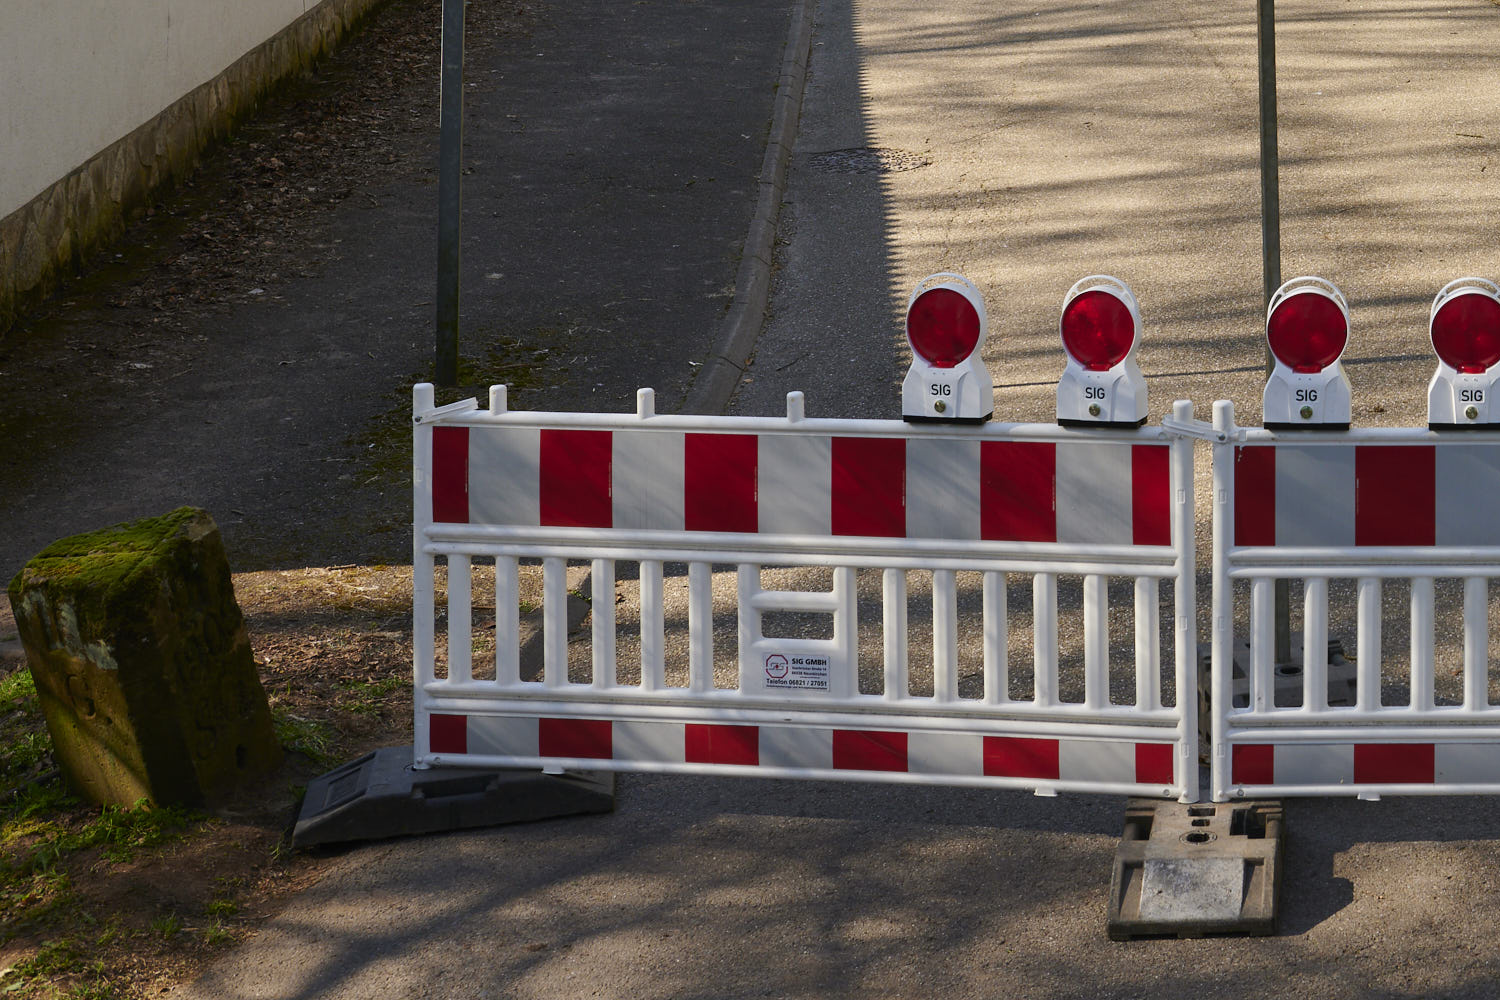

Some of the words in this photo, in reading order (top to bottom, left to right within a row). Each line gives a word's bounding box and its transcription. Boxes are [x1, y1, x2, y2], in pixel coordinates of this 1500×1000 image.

[931, 384, 951, 396] SIG
[1085, 387, 1105, 400] SIG
[1295, 389, 1318, 402] SIG
[1461, 390, 1484, 402] SIG
[805, 658, 827, 666] GMBH
